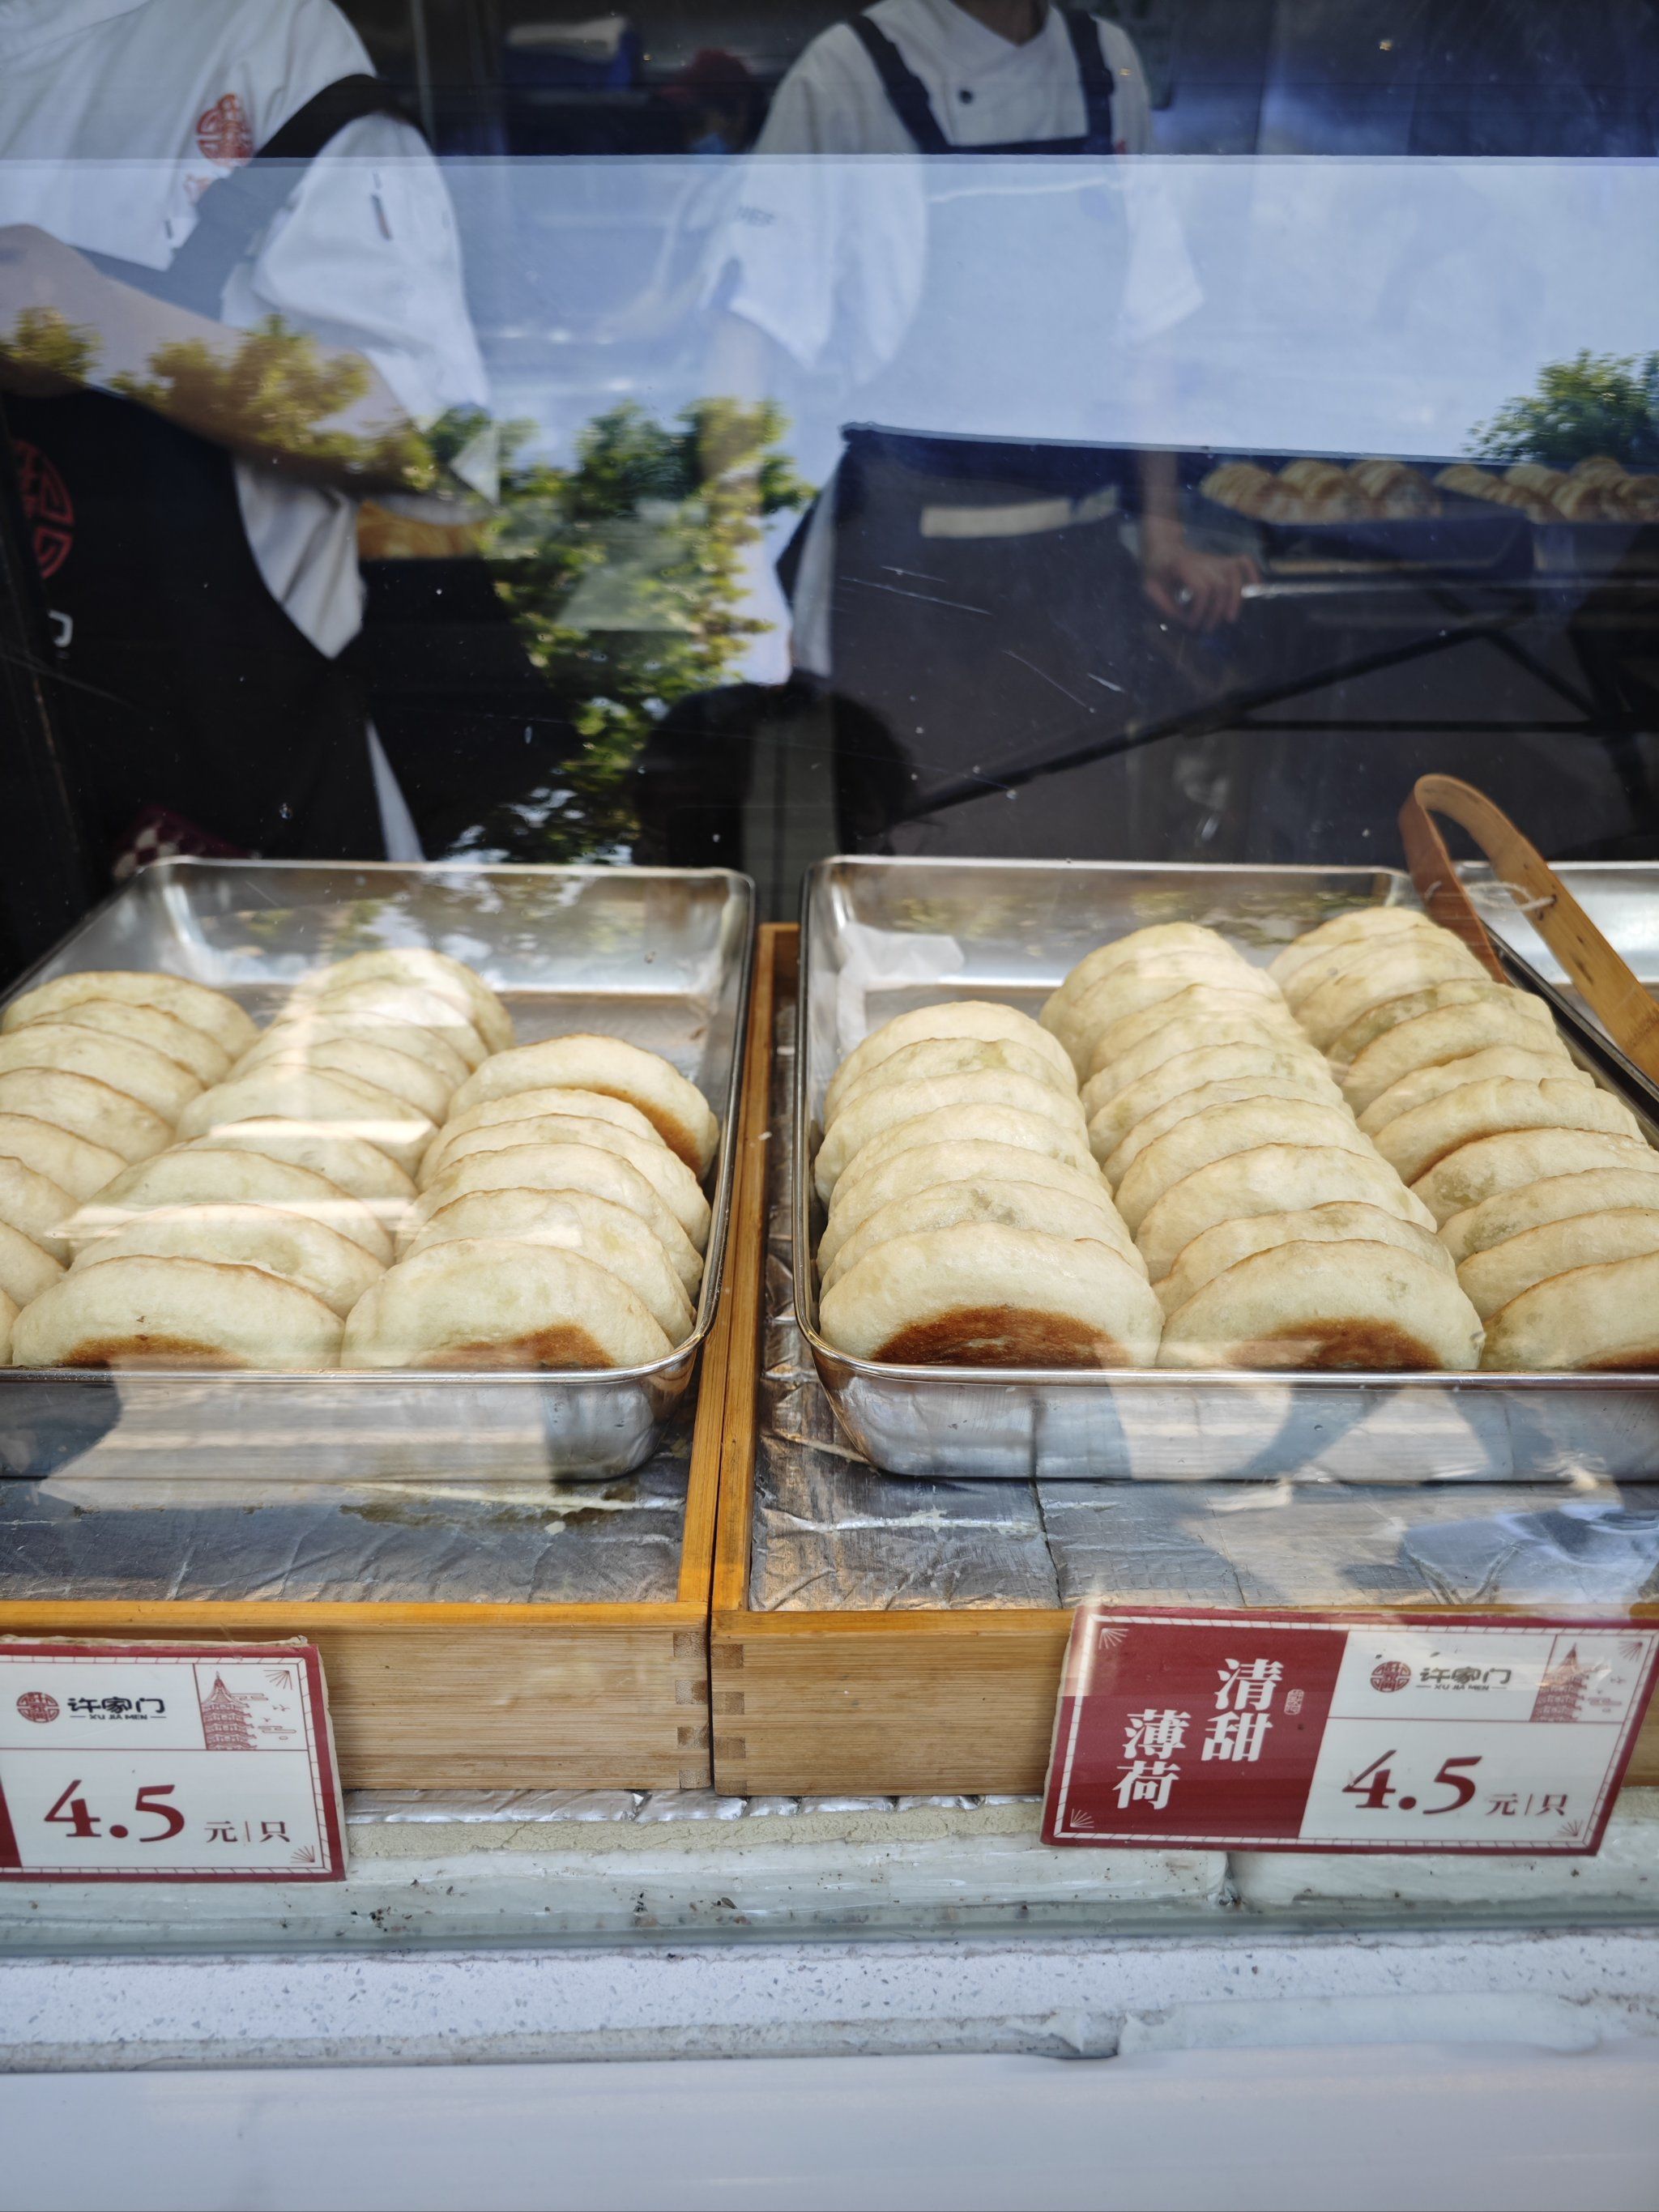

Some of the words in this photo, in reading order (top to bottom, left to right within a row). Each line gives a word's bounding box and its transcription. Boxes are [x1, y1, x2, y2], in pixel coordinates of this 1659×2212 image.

[67, 1696, 166, 1714] 许家门
[1419, 1666, 1512, 1685] 许家门
[1201, 1658, 1284, 1762] 清甜
[1112, 1708, 1192, 1809] 薄荷
[1341, 1750, 1482, 1815] 4.5
[44, 1779, 186, 1843] 4.5
